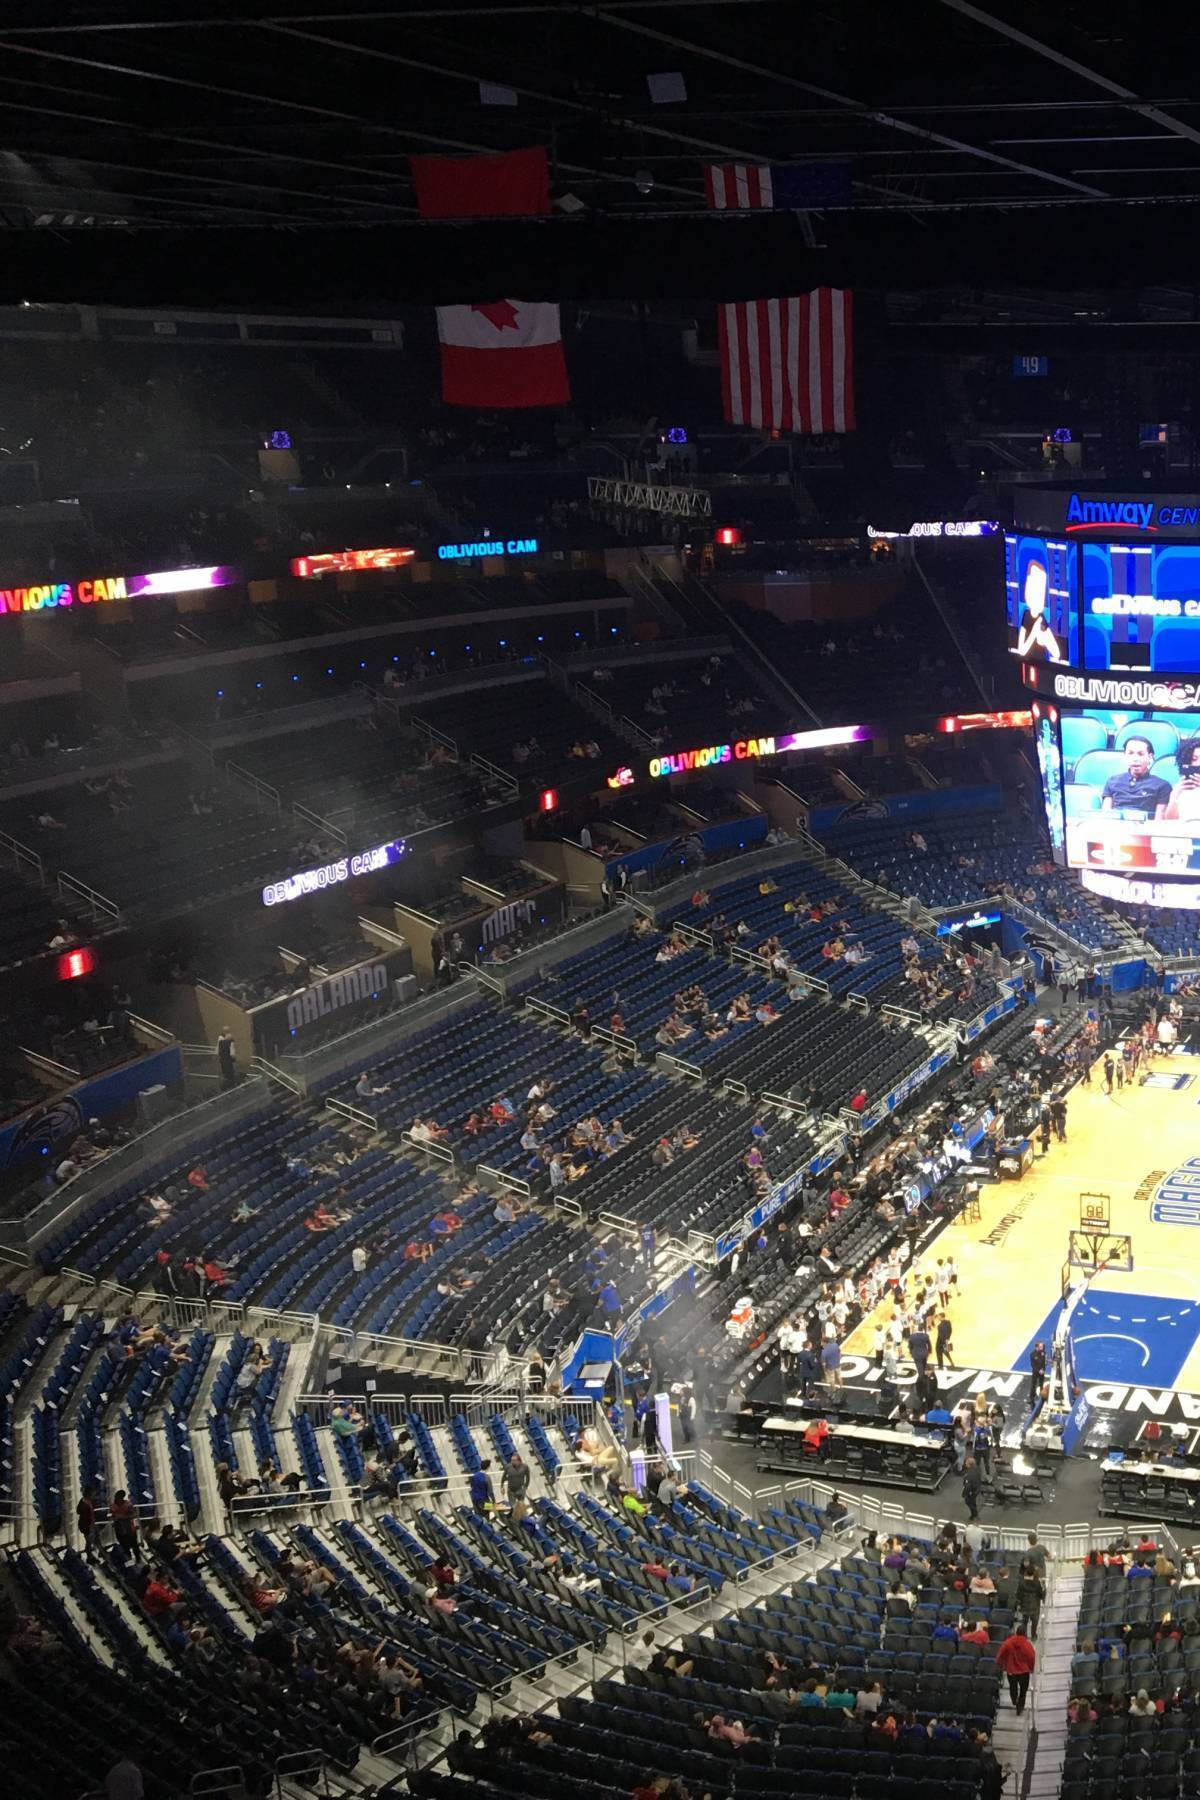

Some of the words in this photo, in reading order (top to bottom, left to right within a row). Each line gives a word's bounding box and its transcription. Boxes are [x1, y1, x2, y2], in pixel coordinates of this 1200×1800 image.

[1023, 356, 1039, 373] 49
[1066, 493, 1154, 530] Amway
[438, 541, 505, 560] OBLIVIOUS
[507, 539, 538, 554] CAM
[77, 576, 128, 604] CAM
[649, 744, 732, 777] OBLIVIOUS
[734, 737, 776, 760] CAM
[287, 963, 387, 1030] ORLANDO
[1133, 1170, 1167, 1200] ORLANDO
[761, 1196, 781, 1220] PURE
[978, 1210, 1023, 1247] Amway
